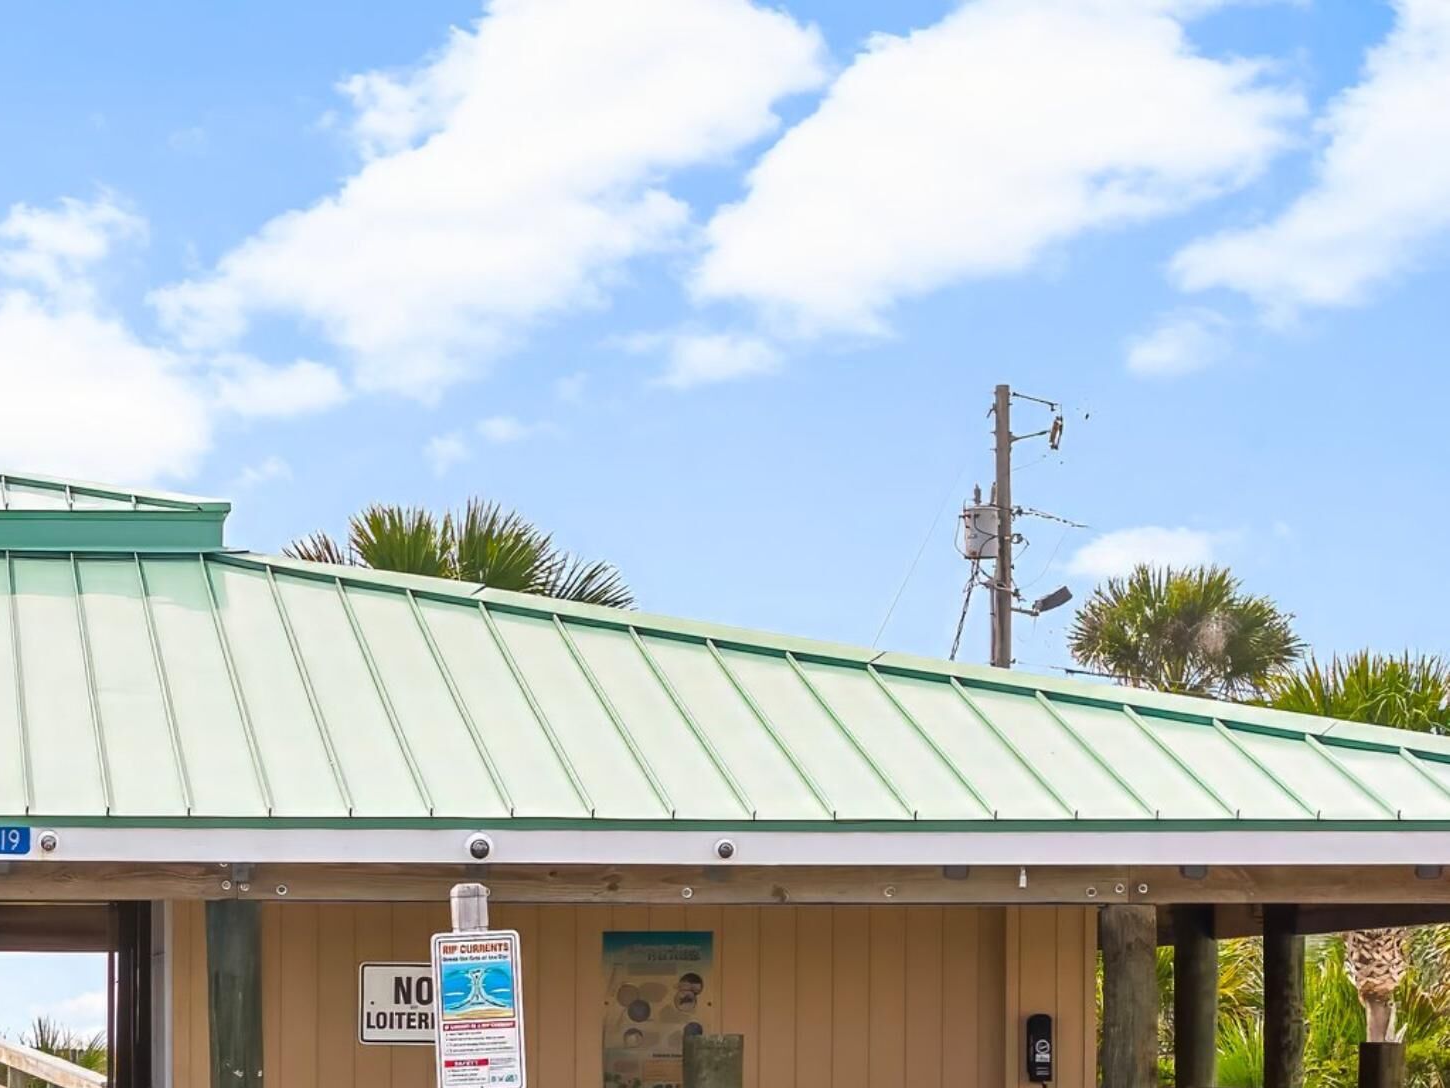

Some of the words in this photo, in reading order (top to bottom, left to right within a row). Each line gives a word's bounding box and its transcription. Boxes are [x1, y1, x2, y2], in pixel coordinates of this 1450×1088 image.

[459, 942, 509, 954] CURRENTS
[393, 976, 433, 1006] NO
[366, 1011, 435, 1030] LOITERI
